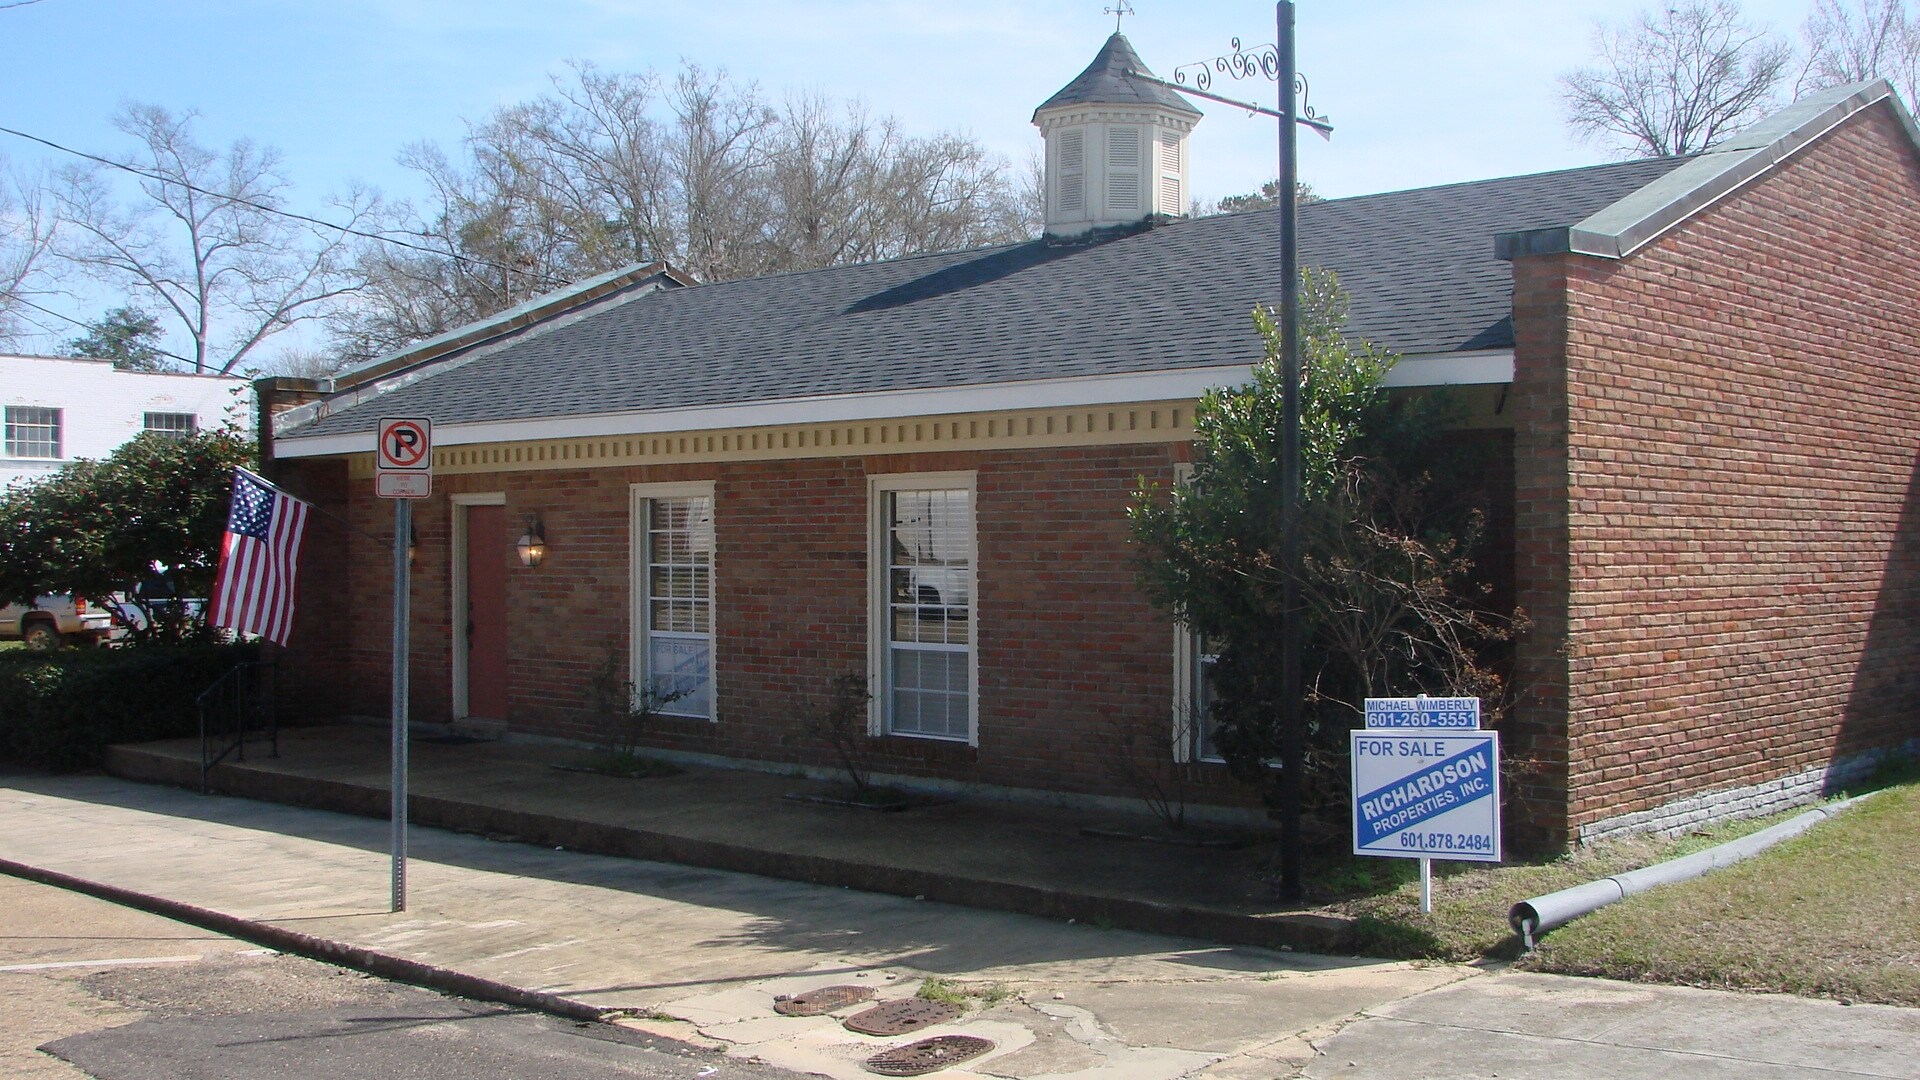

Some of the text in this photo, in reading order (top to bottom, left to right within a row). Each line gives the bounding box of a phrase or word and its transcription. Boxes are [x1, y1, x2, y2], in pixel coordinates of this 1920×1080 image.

[656, 643, 694, 655] FOR SALE
[1366, 700, 1475, 711] MICHAEL WIMBERLY
[1368, 712, 1476, 727] 601-260-5551
[1359, 741, 1445, 757] FOR SALE
[1361, 751, 1487, 820] RICHARDSON
[1372, 777, 1489, 835] PROPERTIES, INC.
[1401, 832, 1491, 851] 601.878.2484
